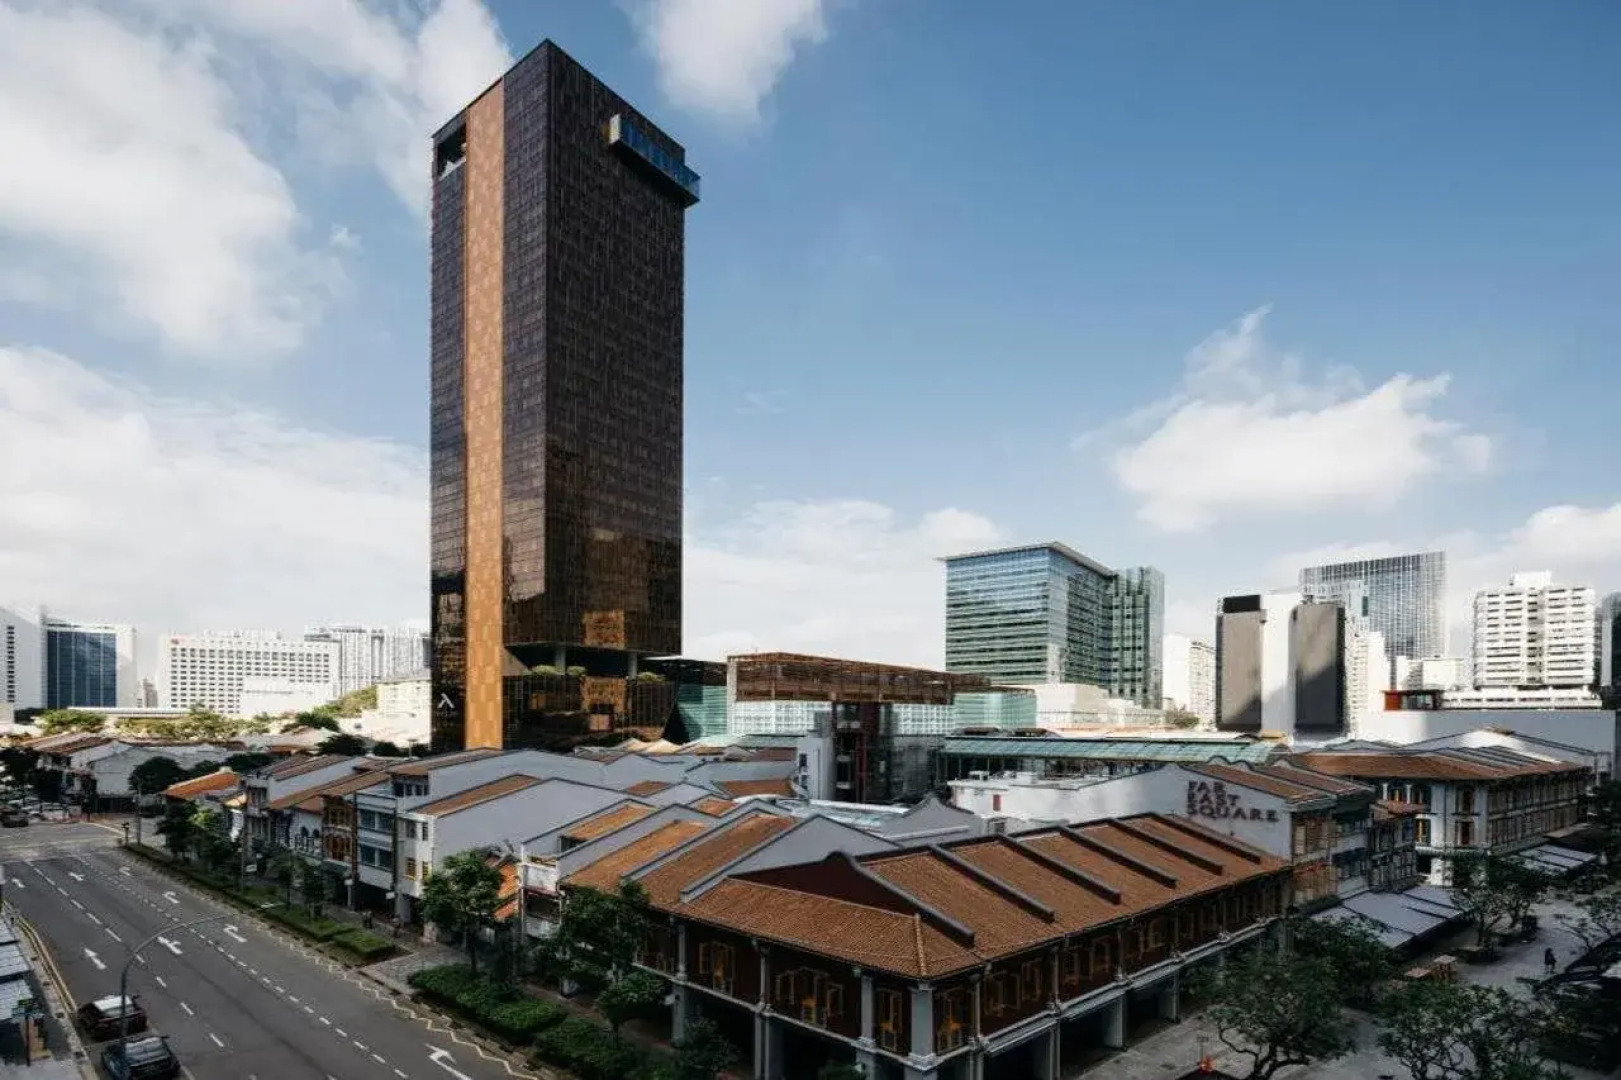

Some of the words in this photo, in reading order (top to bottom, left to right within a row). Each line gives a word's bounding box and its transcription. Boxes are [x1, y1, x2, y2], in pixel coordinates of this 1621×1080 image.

[1188, 781, 1226, 794] FAR
[1187, 793, 1240, 806] EAST
[1187, 804, 1279, 822] SQUARE
